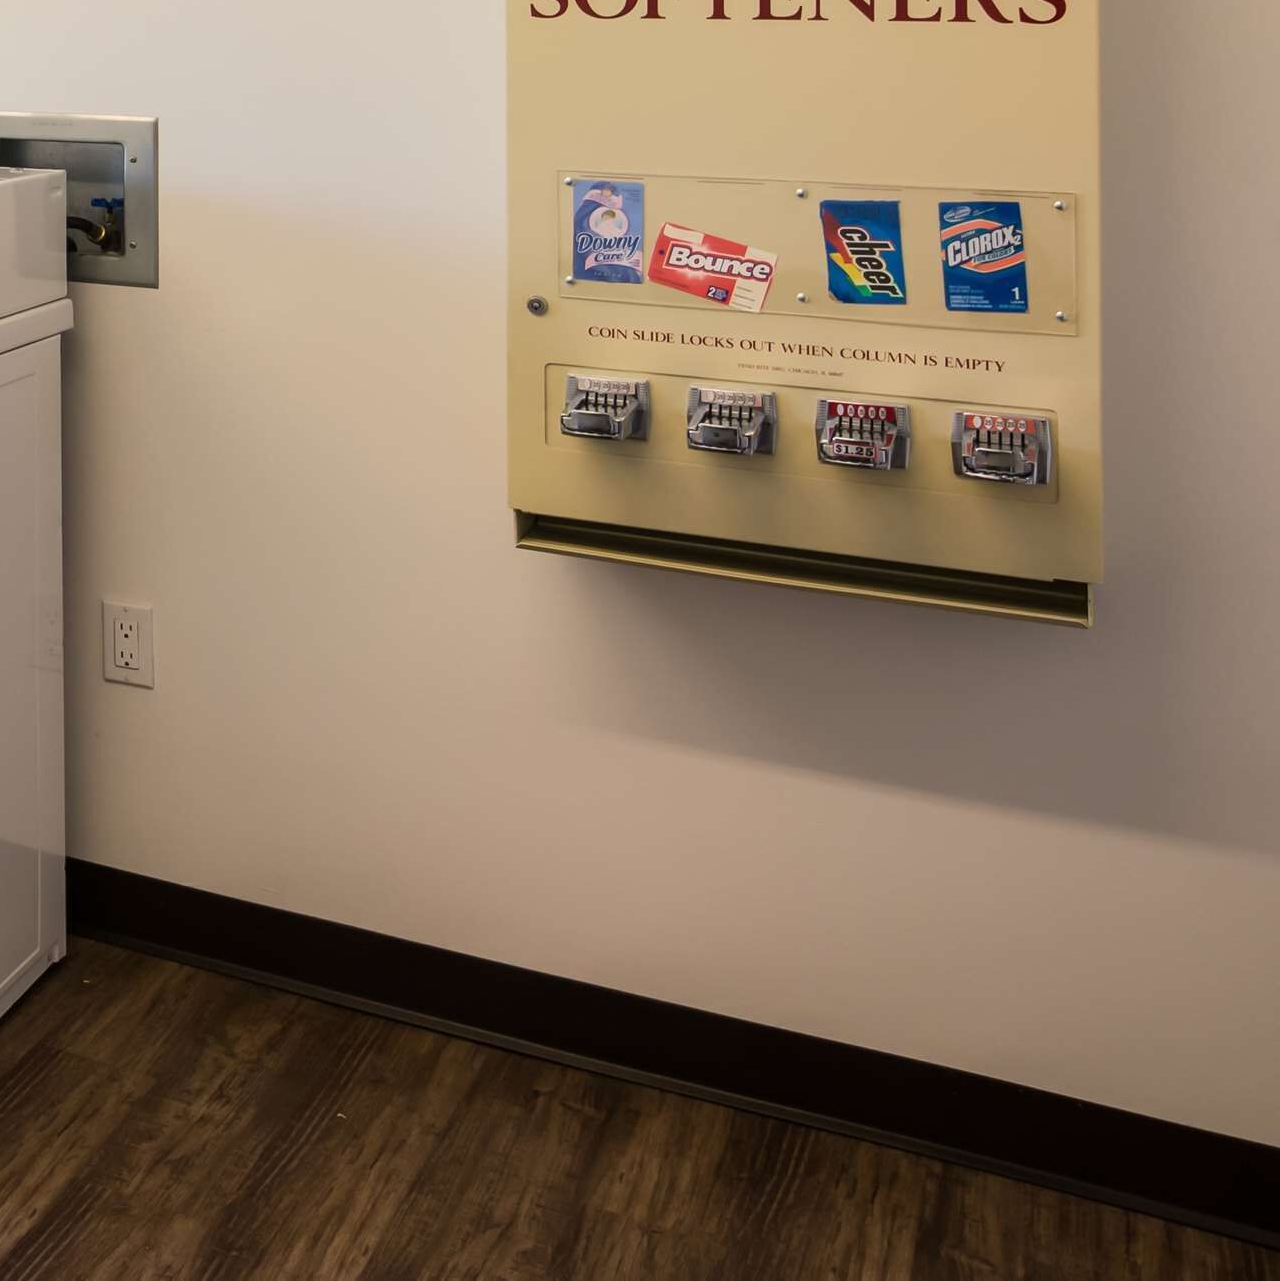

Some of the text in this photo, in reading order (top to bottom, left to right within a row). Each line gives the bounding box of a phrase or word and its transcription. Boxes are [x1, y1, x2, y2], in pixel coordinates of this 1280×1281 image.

[576, 232, 641, 259] Downy
[667, 245, 771, 280] Bounce
[707, 286, 717, 298] 2
[587, 325, 1006, 373] COIN SLIDE LOCKS OUT WHEN COLUMN IS EMPTY
[835, 444, 874, 457] $1.25
